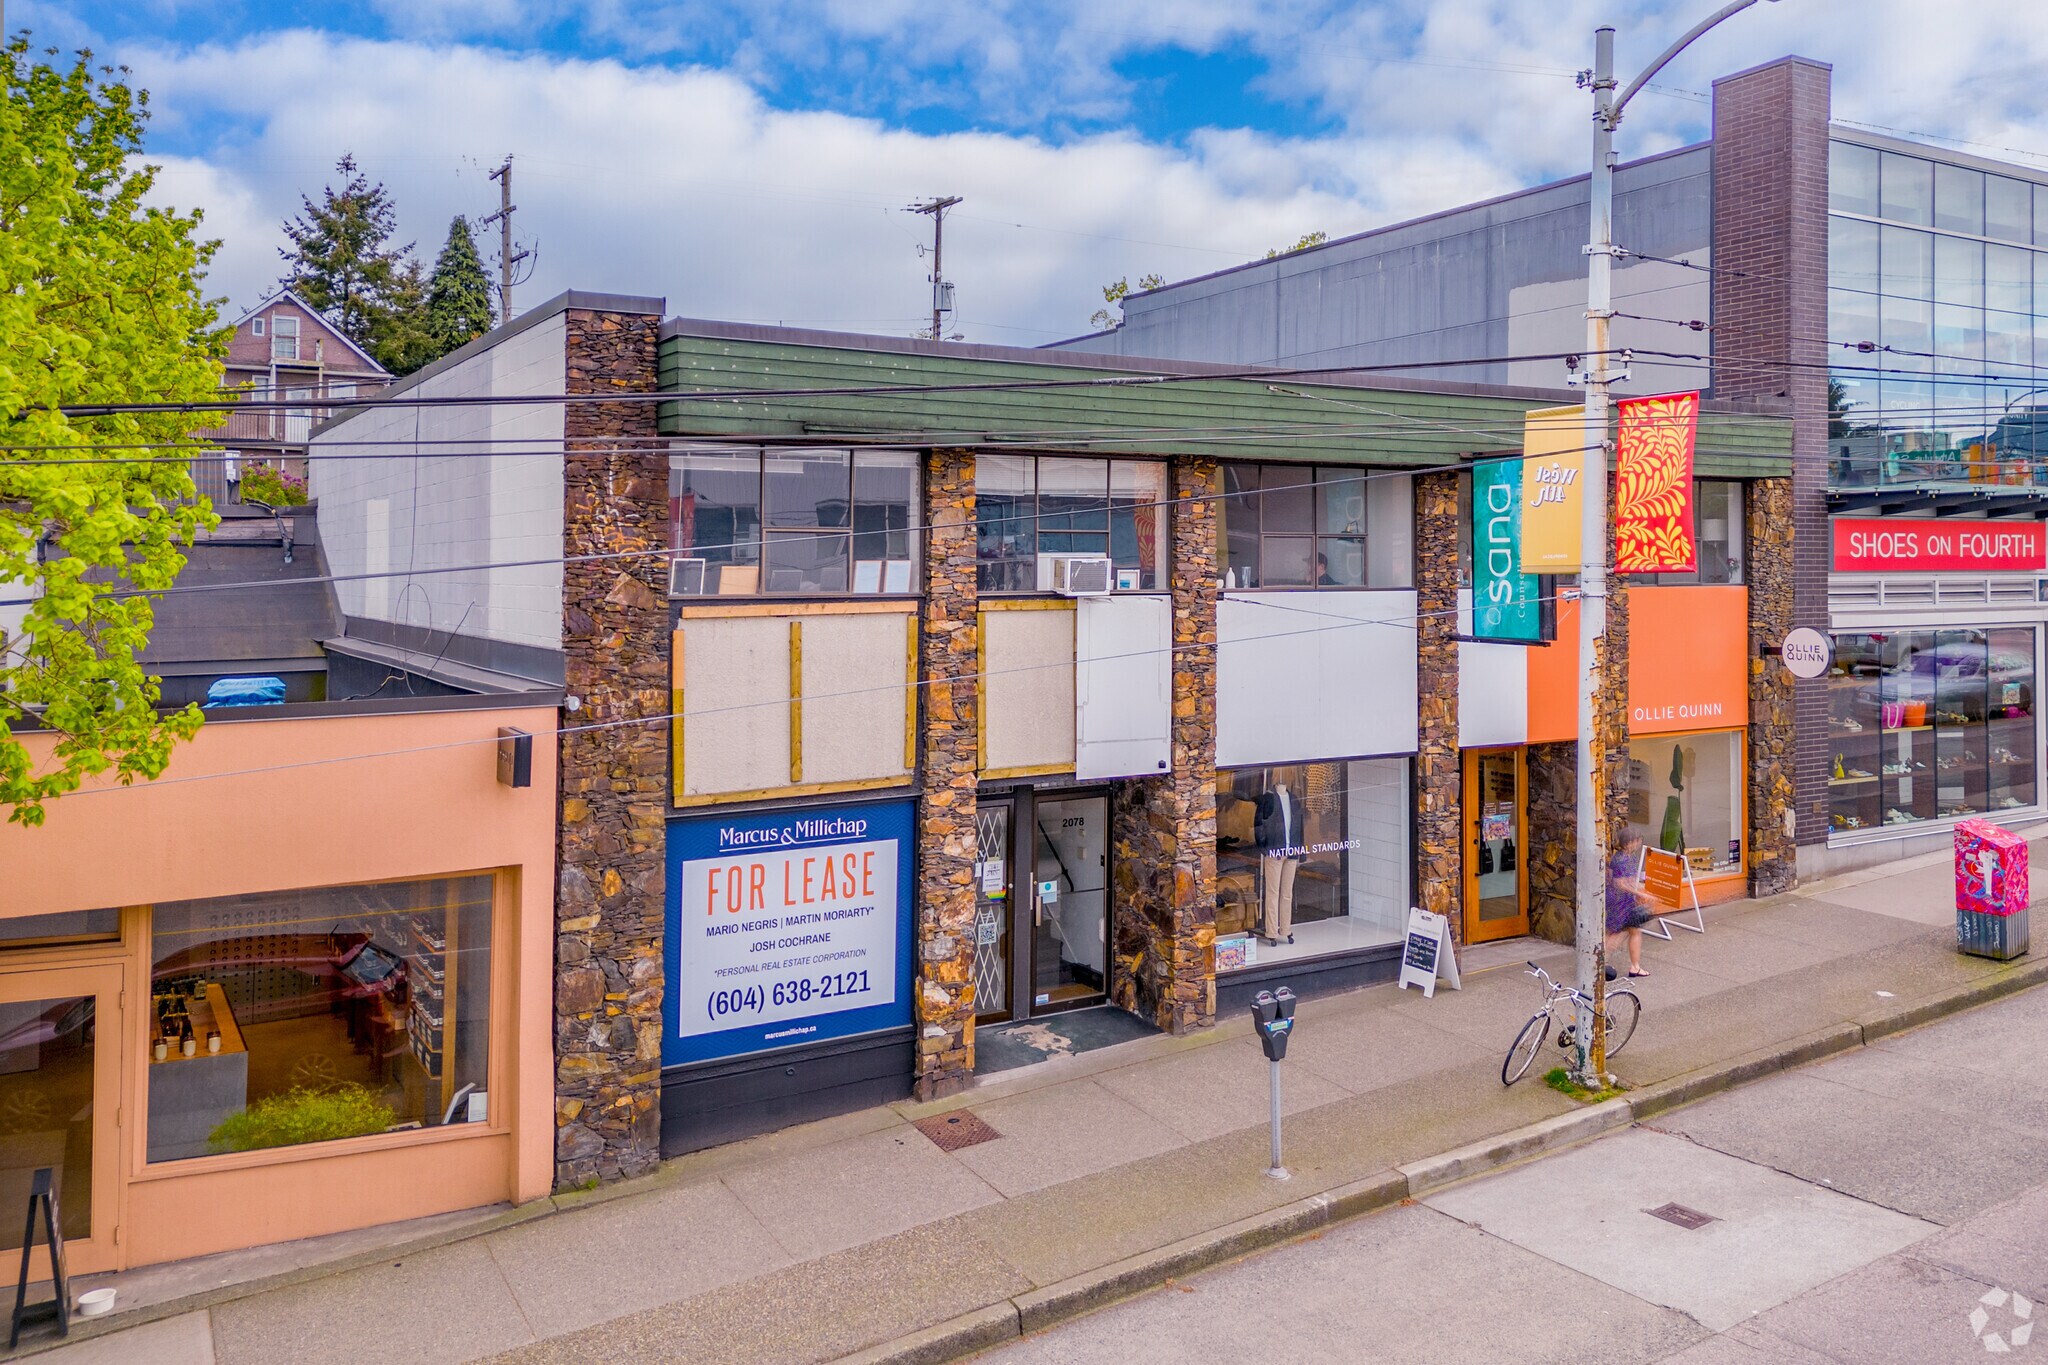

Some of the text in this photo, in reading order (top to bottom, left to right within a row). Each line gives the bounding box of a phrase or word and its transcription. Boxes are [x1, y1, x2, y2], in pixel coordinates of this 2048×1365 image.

[1850, 532, 2035, 558] SHOES ON FOURTH
[1786, 643, 1820, 654] OLLIE
[1786, 650, 1824, 663] QUINN
[1634, 702, 1722, 721] OLLIE QUINN
[719, 828, 778, 846] Marcus
[795, 817, 868, 838] Millichap
[1062, 817, 1085, 828] 2078
[1269, 839, 1361, 858] NATIONAL STANDARDS
[707, 851, 875, 916] FOR LEASE
[706, 923, 739, 937] MARIO
[741, 918, 778, 932] NEGRIS
[785, 912, 822, 926] MARTIN
[750, 932, 831, 952] JOSH COCHRANE
[761, 960, 781, 971] REAL
[783, 956, 811, 968] ESTATE
[812, 948, 867, 964] CORPORATION
[707, 970, 871, 1021] (604) 638-2121
